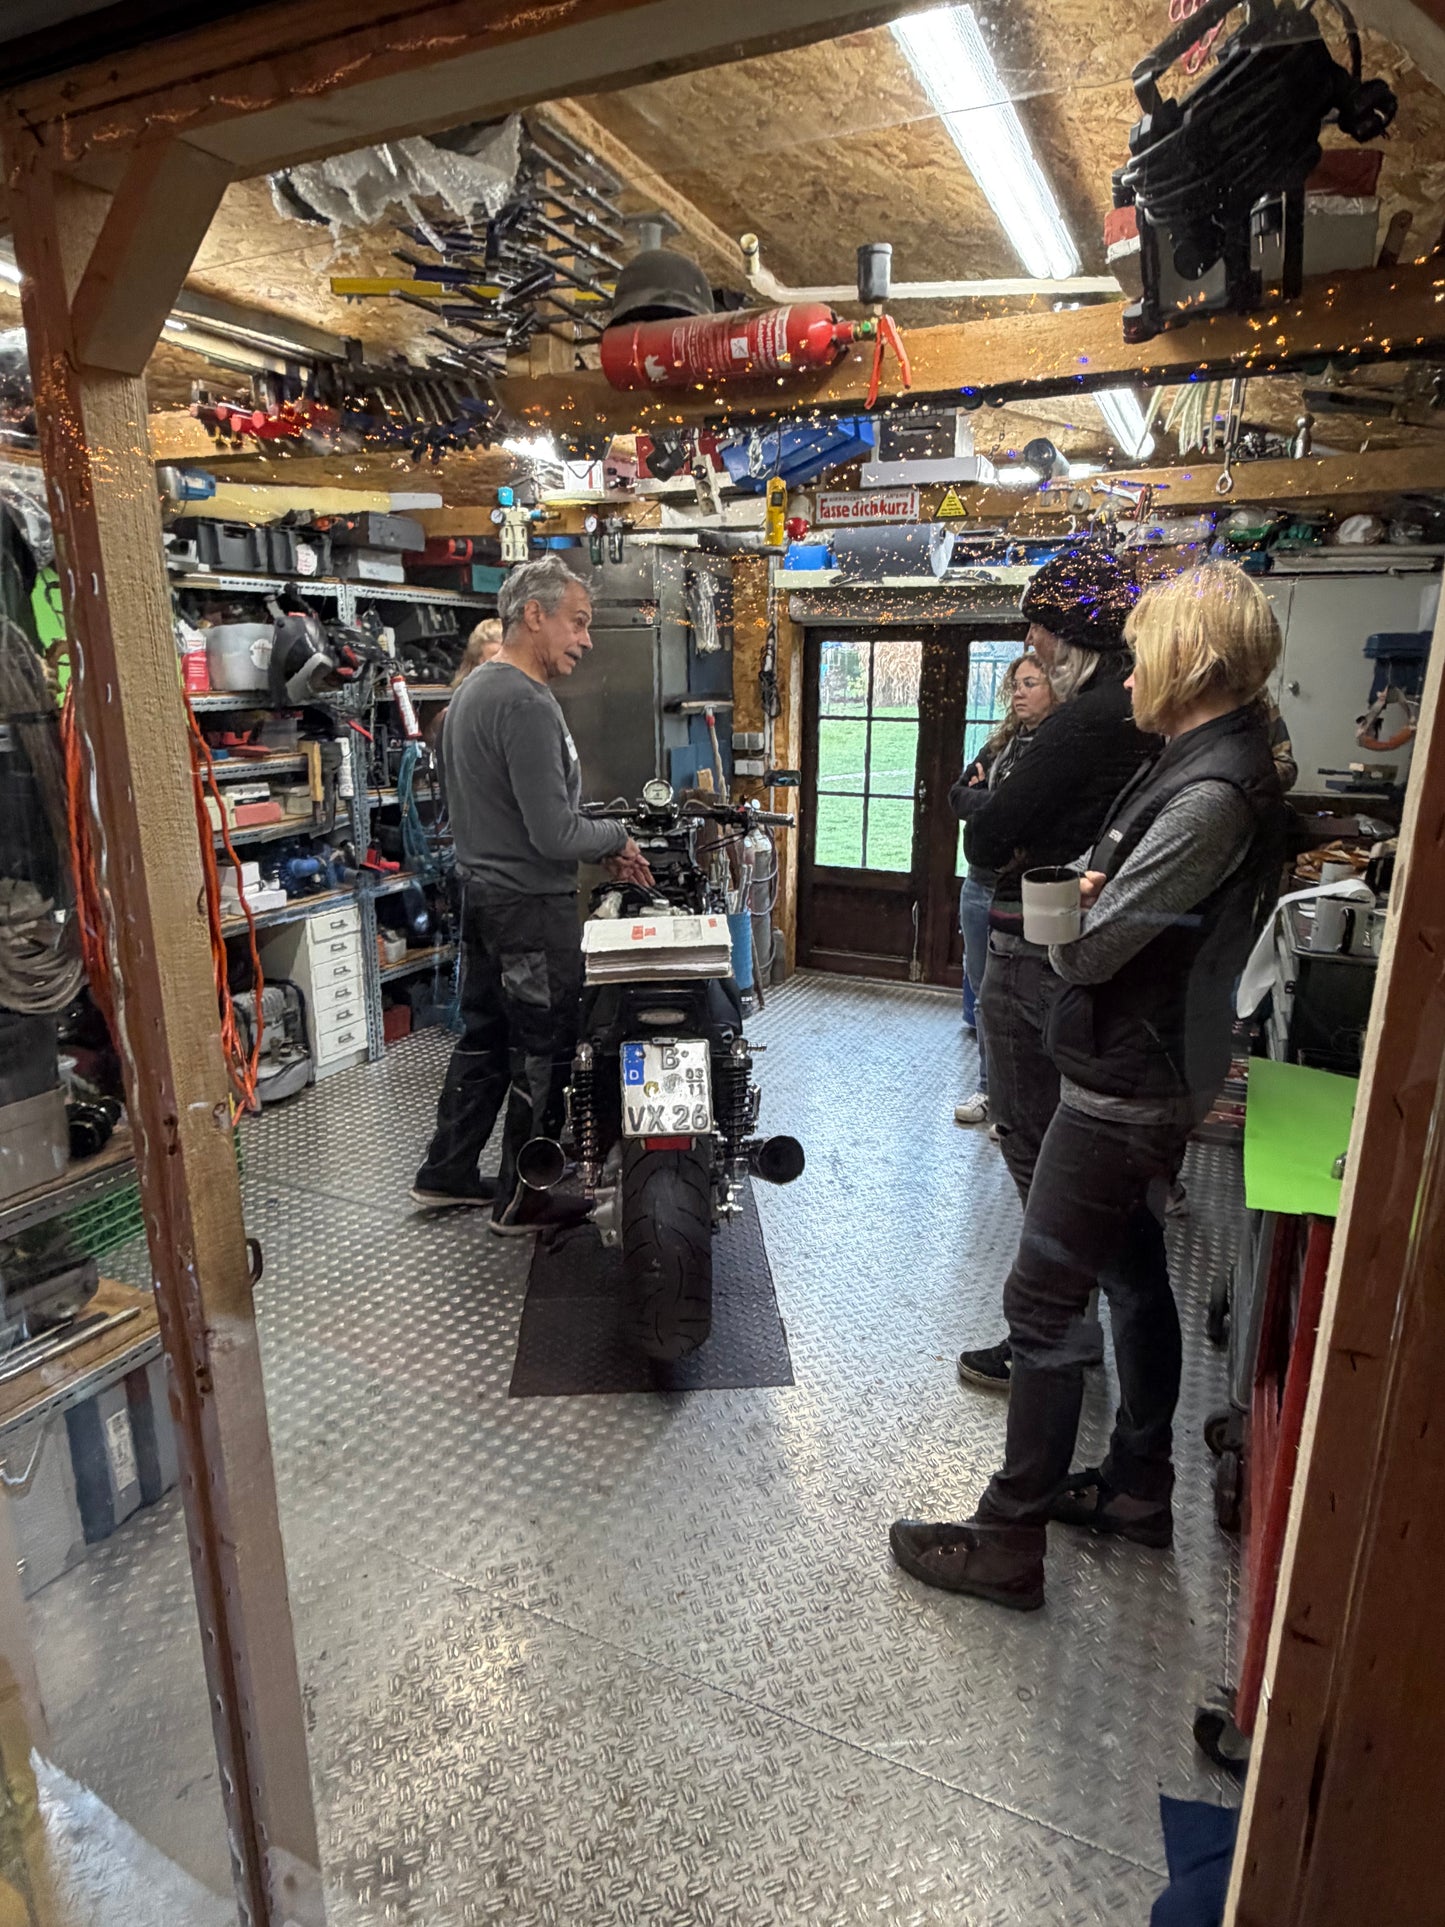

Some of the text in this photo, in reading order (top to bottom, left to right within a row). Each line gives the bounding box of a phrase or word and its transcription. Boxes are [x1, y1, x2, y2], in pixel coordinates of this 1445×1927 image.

[820, 498, 850, 519] Fasse
[851, 500, 879, 517] dich
[879, 492, 915, 516] kurz!
[662, 1046, 680, 1070] B
[629, 1069, 640, 1081] D
[627, 1103, 708, 1132] VX 26
